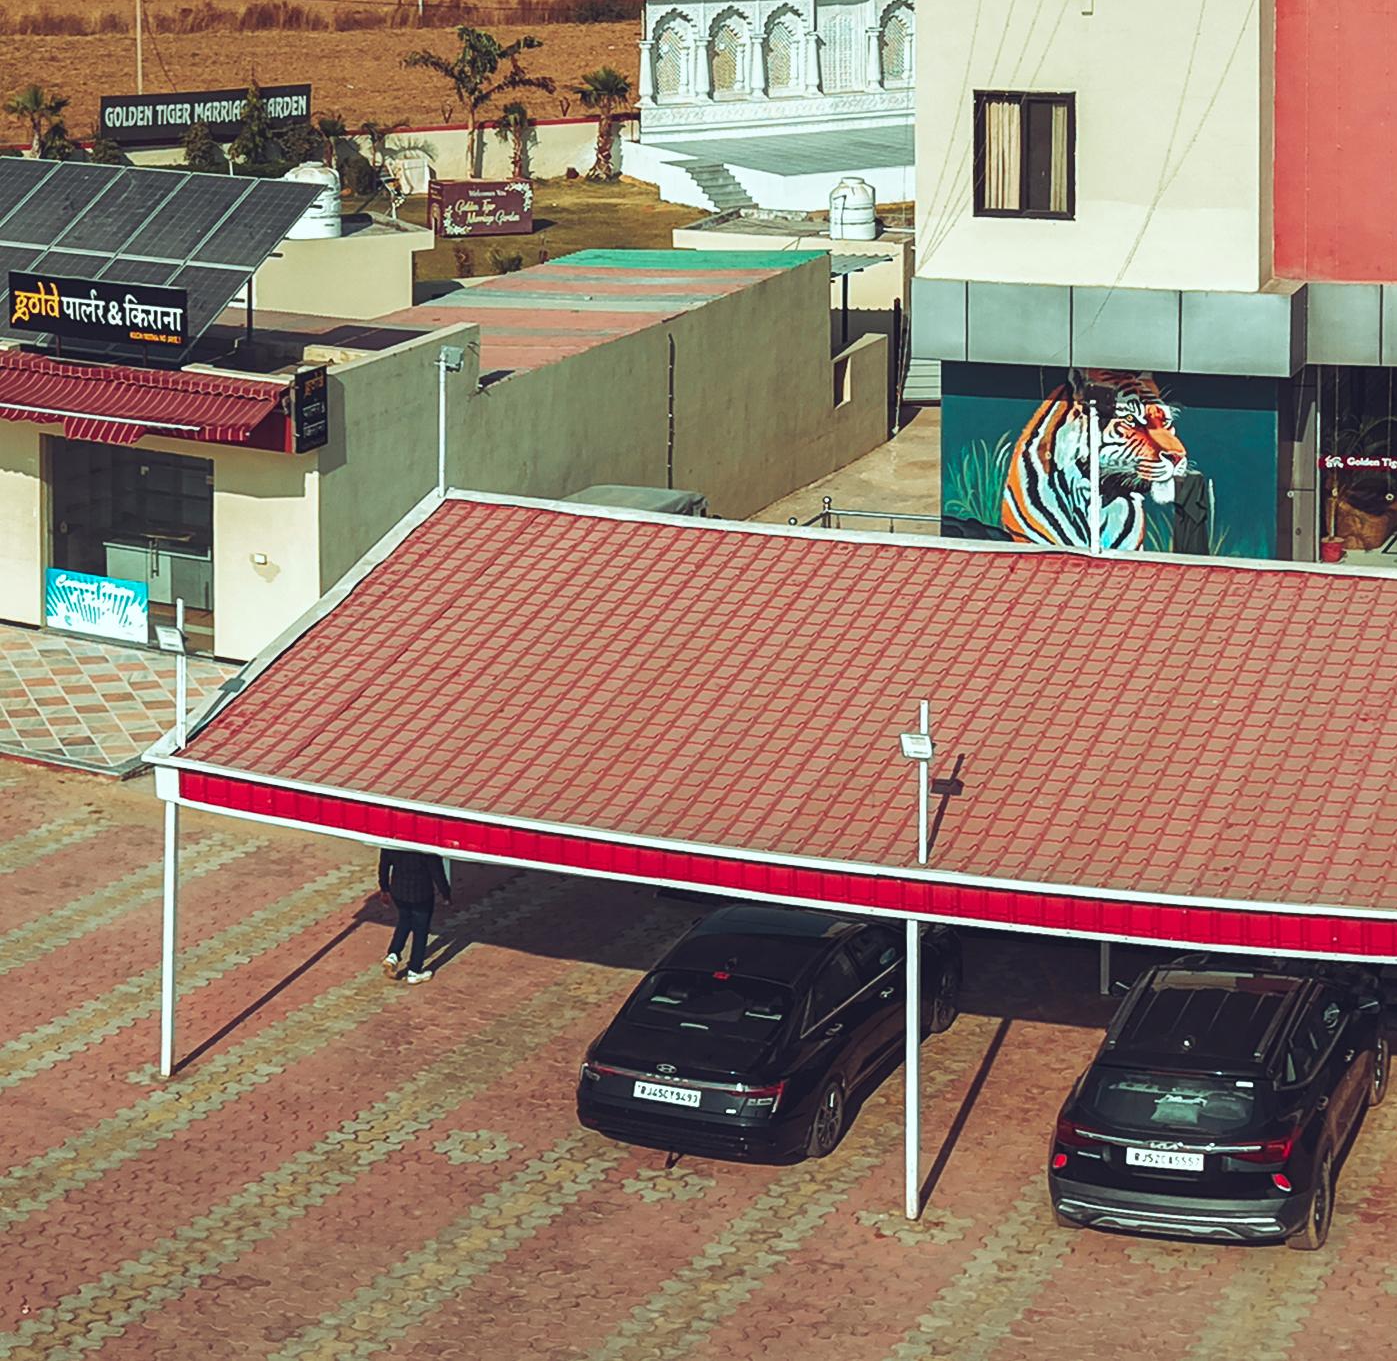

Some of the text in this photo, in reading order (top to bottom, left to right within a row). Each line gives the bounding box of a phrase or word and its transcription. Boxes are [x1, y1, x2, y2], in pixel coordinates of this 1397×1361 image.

[105, 105, 153, 127] GOLDEN
[156, 103, 191, 125] TIGER
[263, 95, 307, 118] ARDEN
[61, 289, 106, 324] पार्लर
[107, 301, 123, 326] &
[123, 294, 184, 331] किराना
[1346, 457, 1380, 467] Golden
